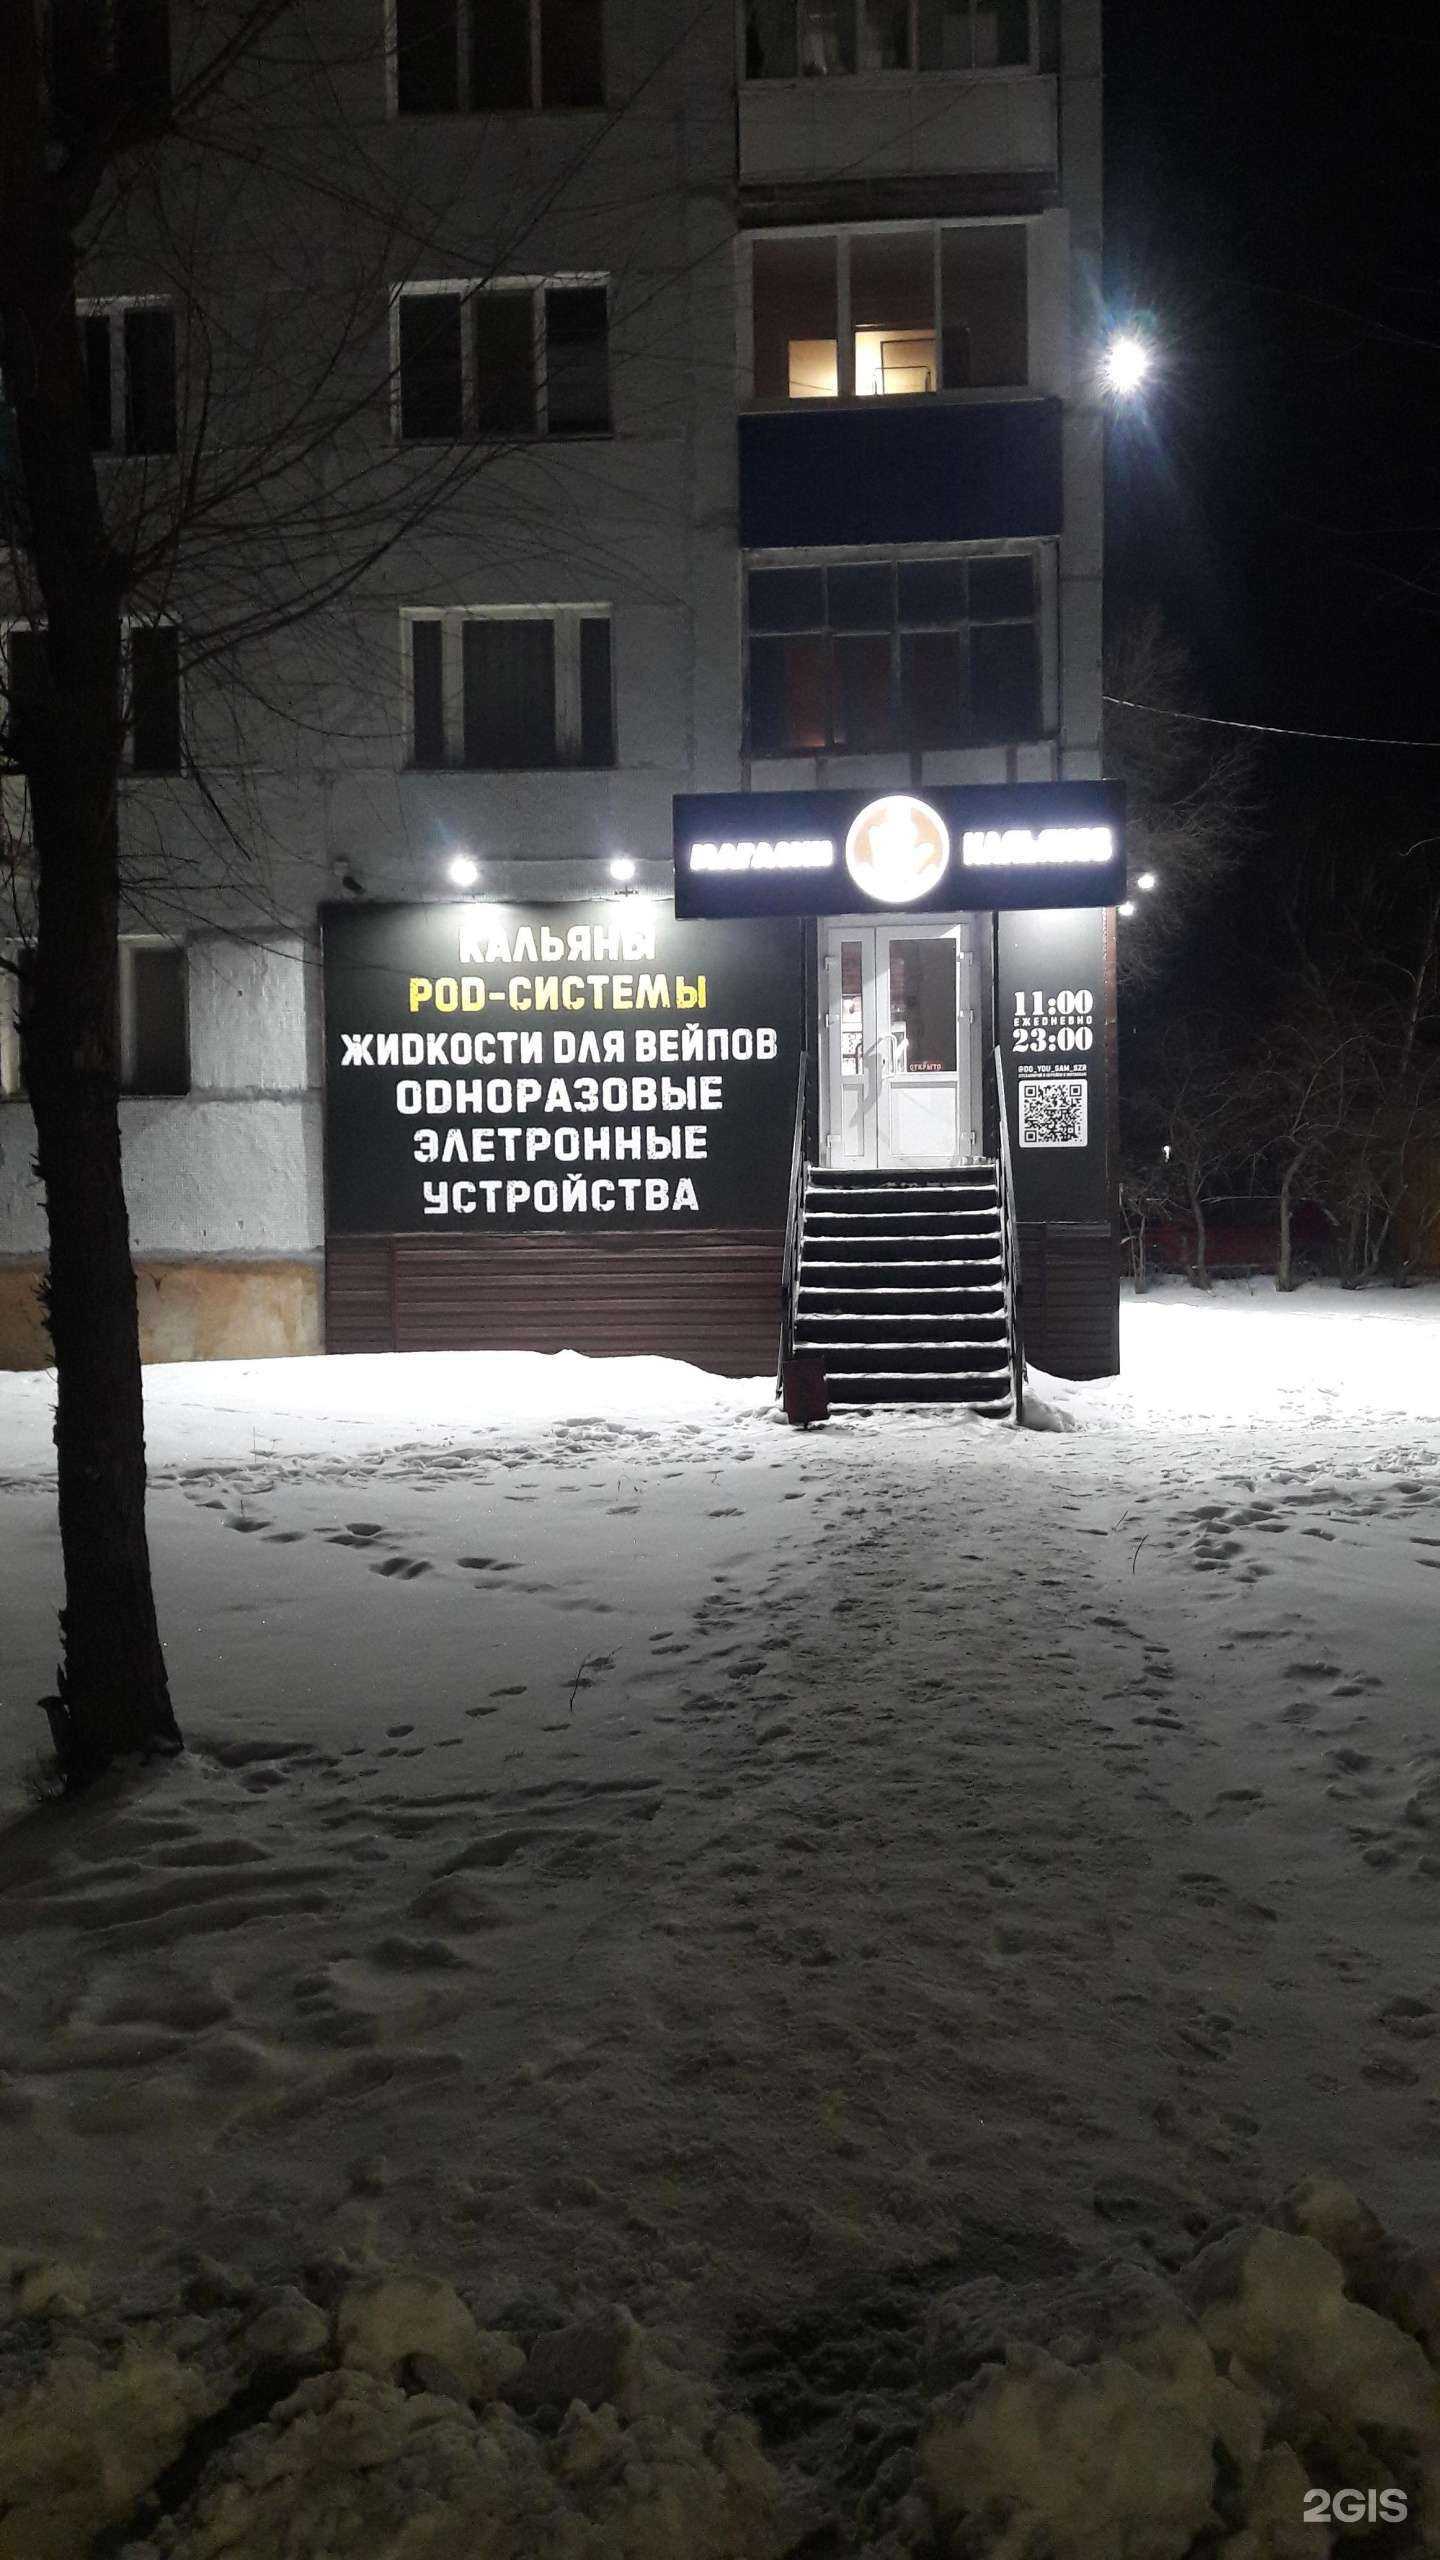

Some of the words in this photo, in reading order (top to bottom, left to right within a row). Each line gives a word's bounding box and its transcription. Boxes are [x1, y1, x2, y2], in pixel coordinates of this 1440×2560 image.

[689, 841, 833, 870] МАГА
[459, 925, 655, 962] КАЛЬЯНЫ
[1014, 989, 1094, 1016] 11:00
[635, 1023, 778, 1062] ВЕЙПОВ
[1012, 1026, 1093, 1052] 23:00
[414, 1126, 708, 1163] ЭЛЕТРОННЫЕ
[424, 1173, 700, 1214] УСТРОЙСТВА
